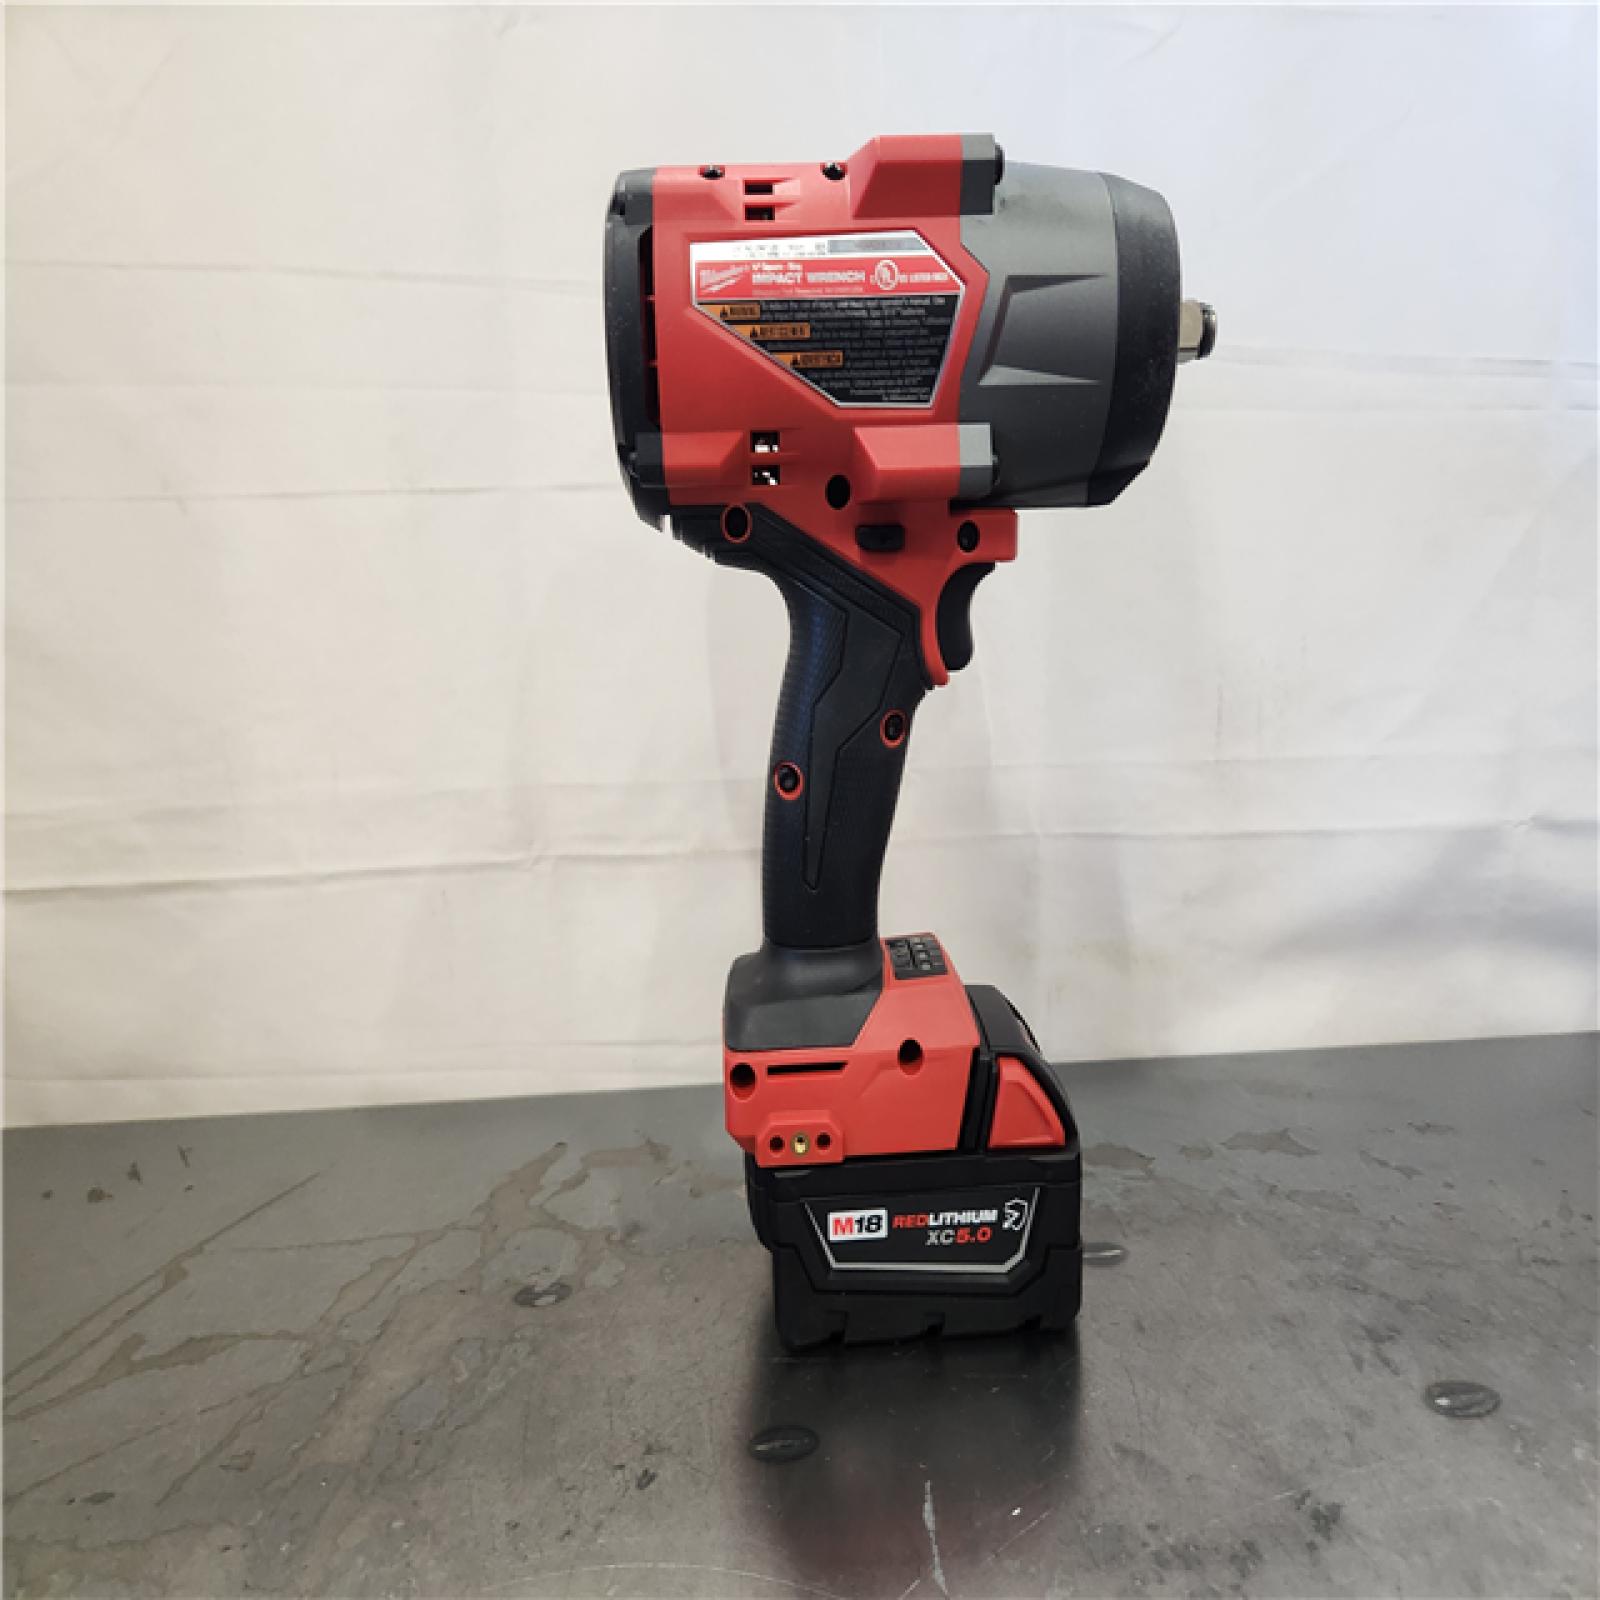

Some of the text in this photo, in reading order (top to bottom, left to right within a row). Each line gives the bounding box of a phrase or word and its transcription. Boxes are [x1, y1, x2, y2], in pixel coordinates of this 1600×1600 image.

[751, 269, 866, 285] IMPACT WRENCH
[832, 1214, 883, 1237] M18
[891, 1208, 998, 1229] REDLITHIUM
